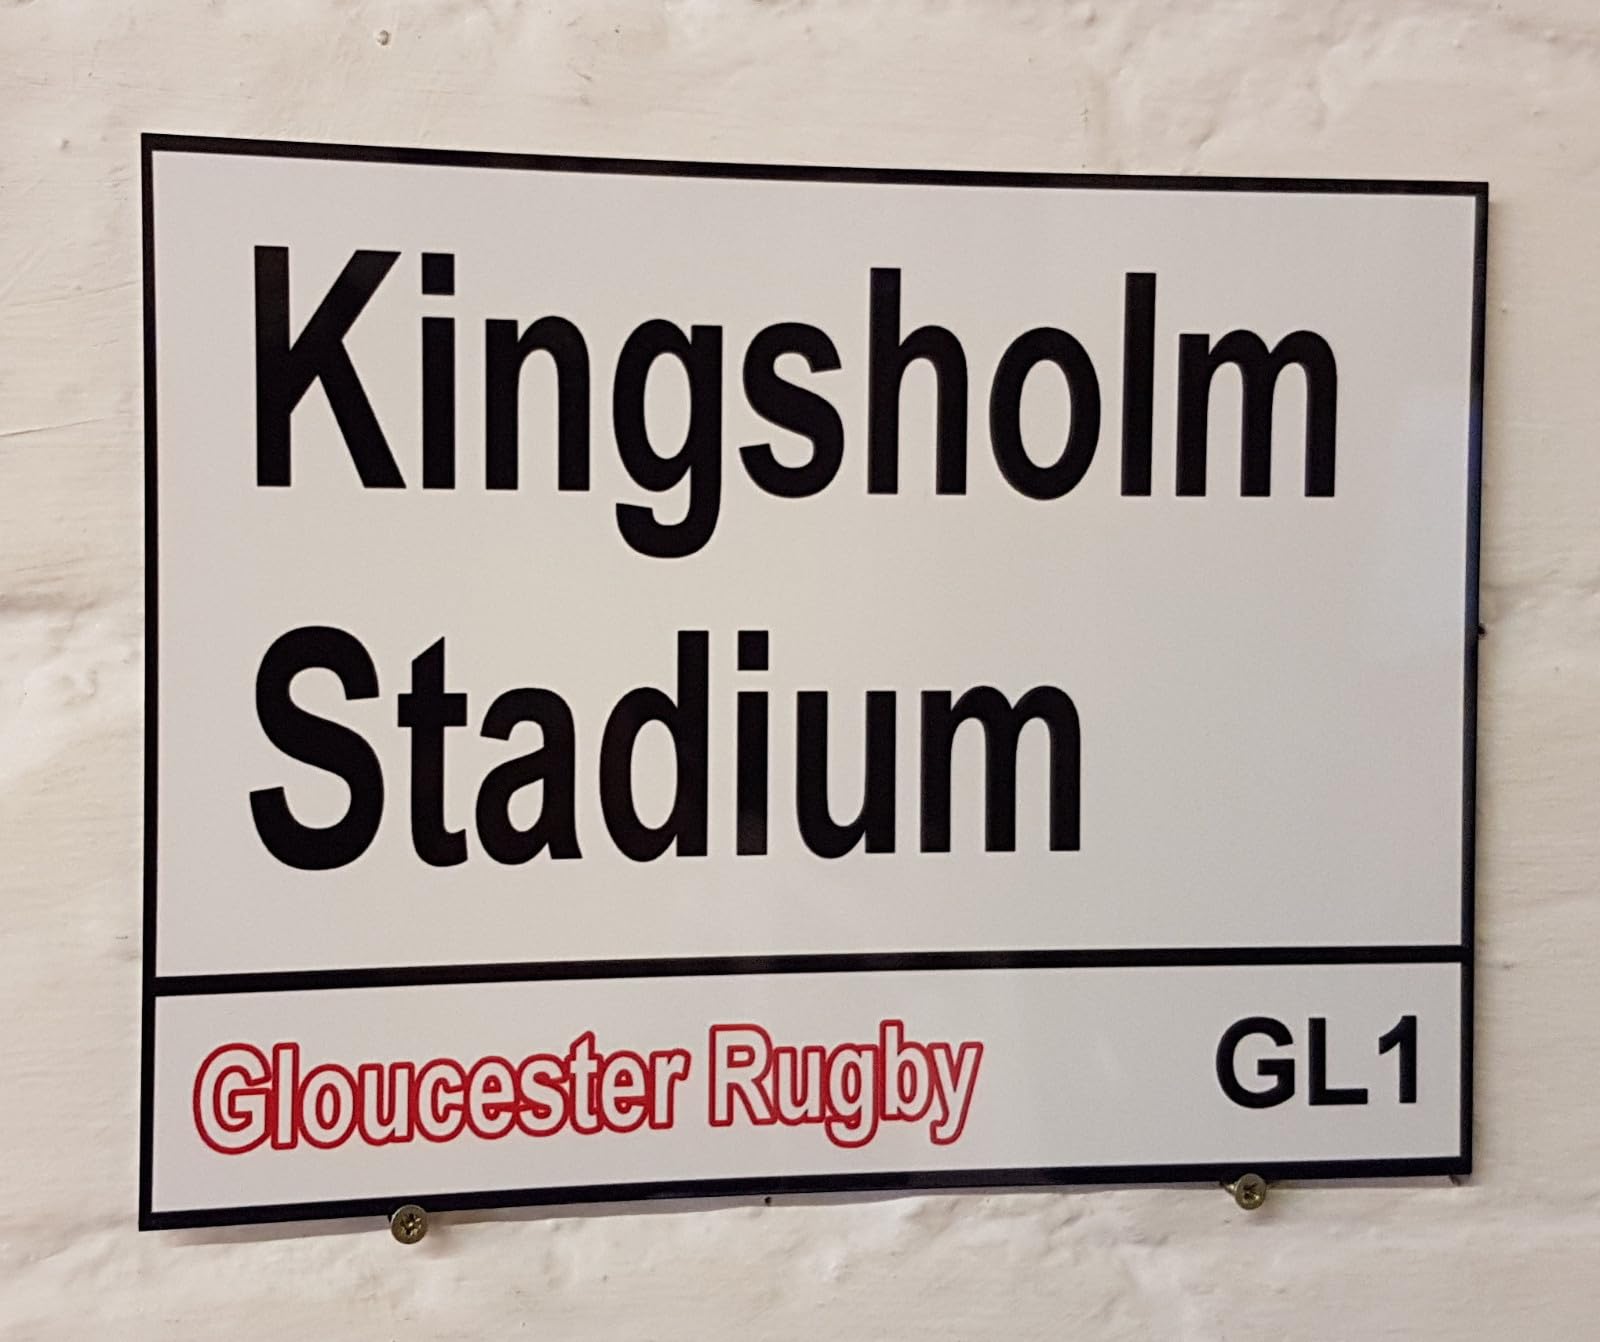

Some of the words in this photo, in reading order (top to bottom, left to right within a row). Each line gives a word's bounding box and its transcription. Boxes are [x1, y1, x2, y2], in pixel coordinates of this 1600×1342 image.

[254, 246, 1337, 558] Kingsholm
[250, 626, 1080, 870] Stadium
[192, 1032, 692, 1155] Gloucester
[708, 1020, 984, 1149] Rugby
[1216, 1016, 1418, 1109] GL1
